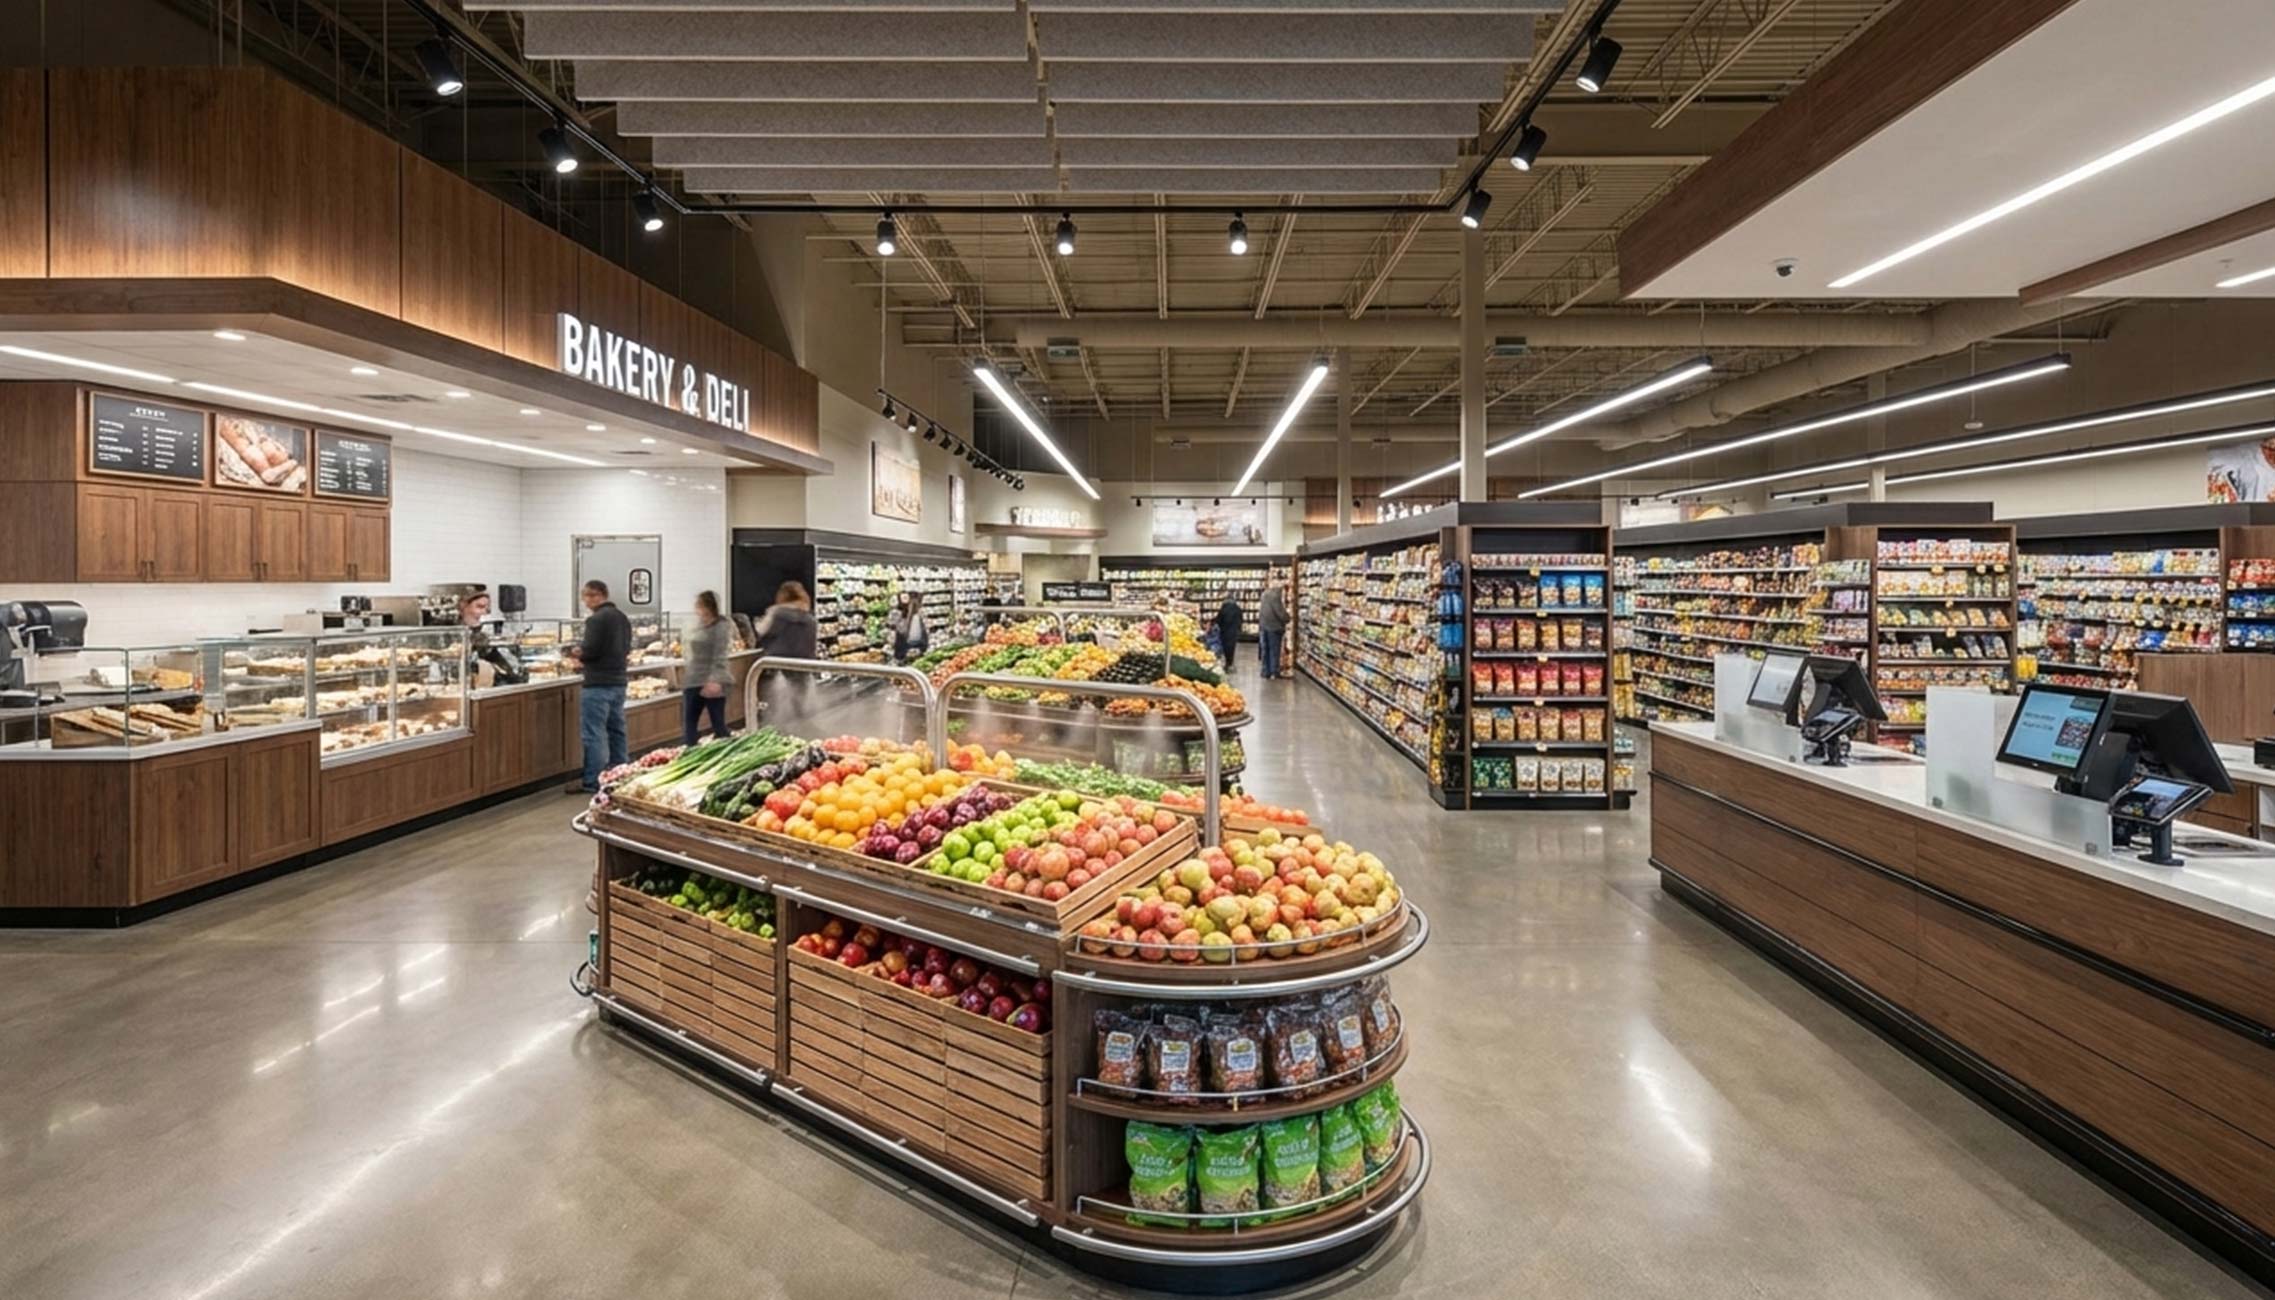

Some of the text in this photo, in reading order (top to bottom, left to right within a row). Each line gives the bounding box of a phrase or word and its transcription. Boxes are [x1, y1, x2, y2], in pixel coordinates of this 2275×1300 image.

[559, 313, 749, 432] BAKERY & DELI
